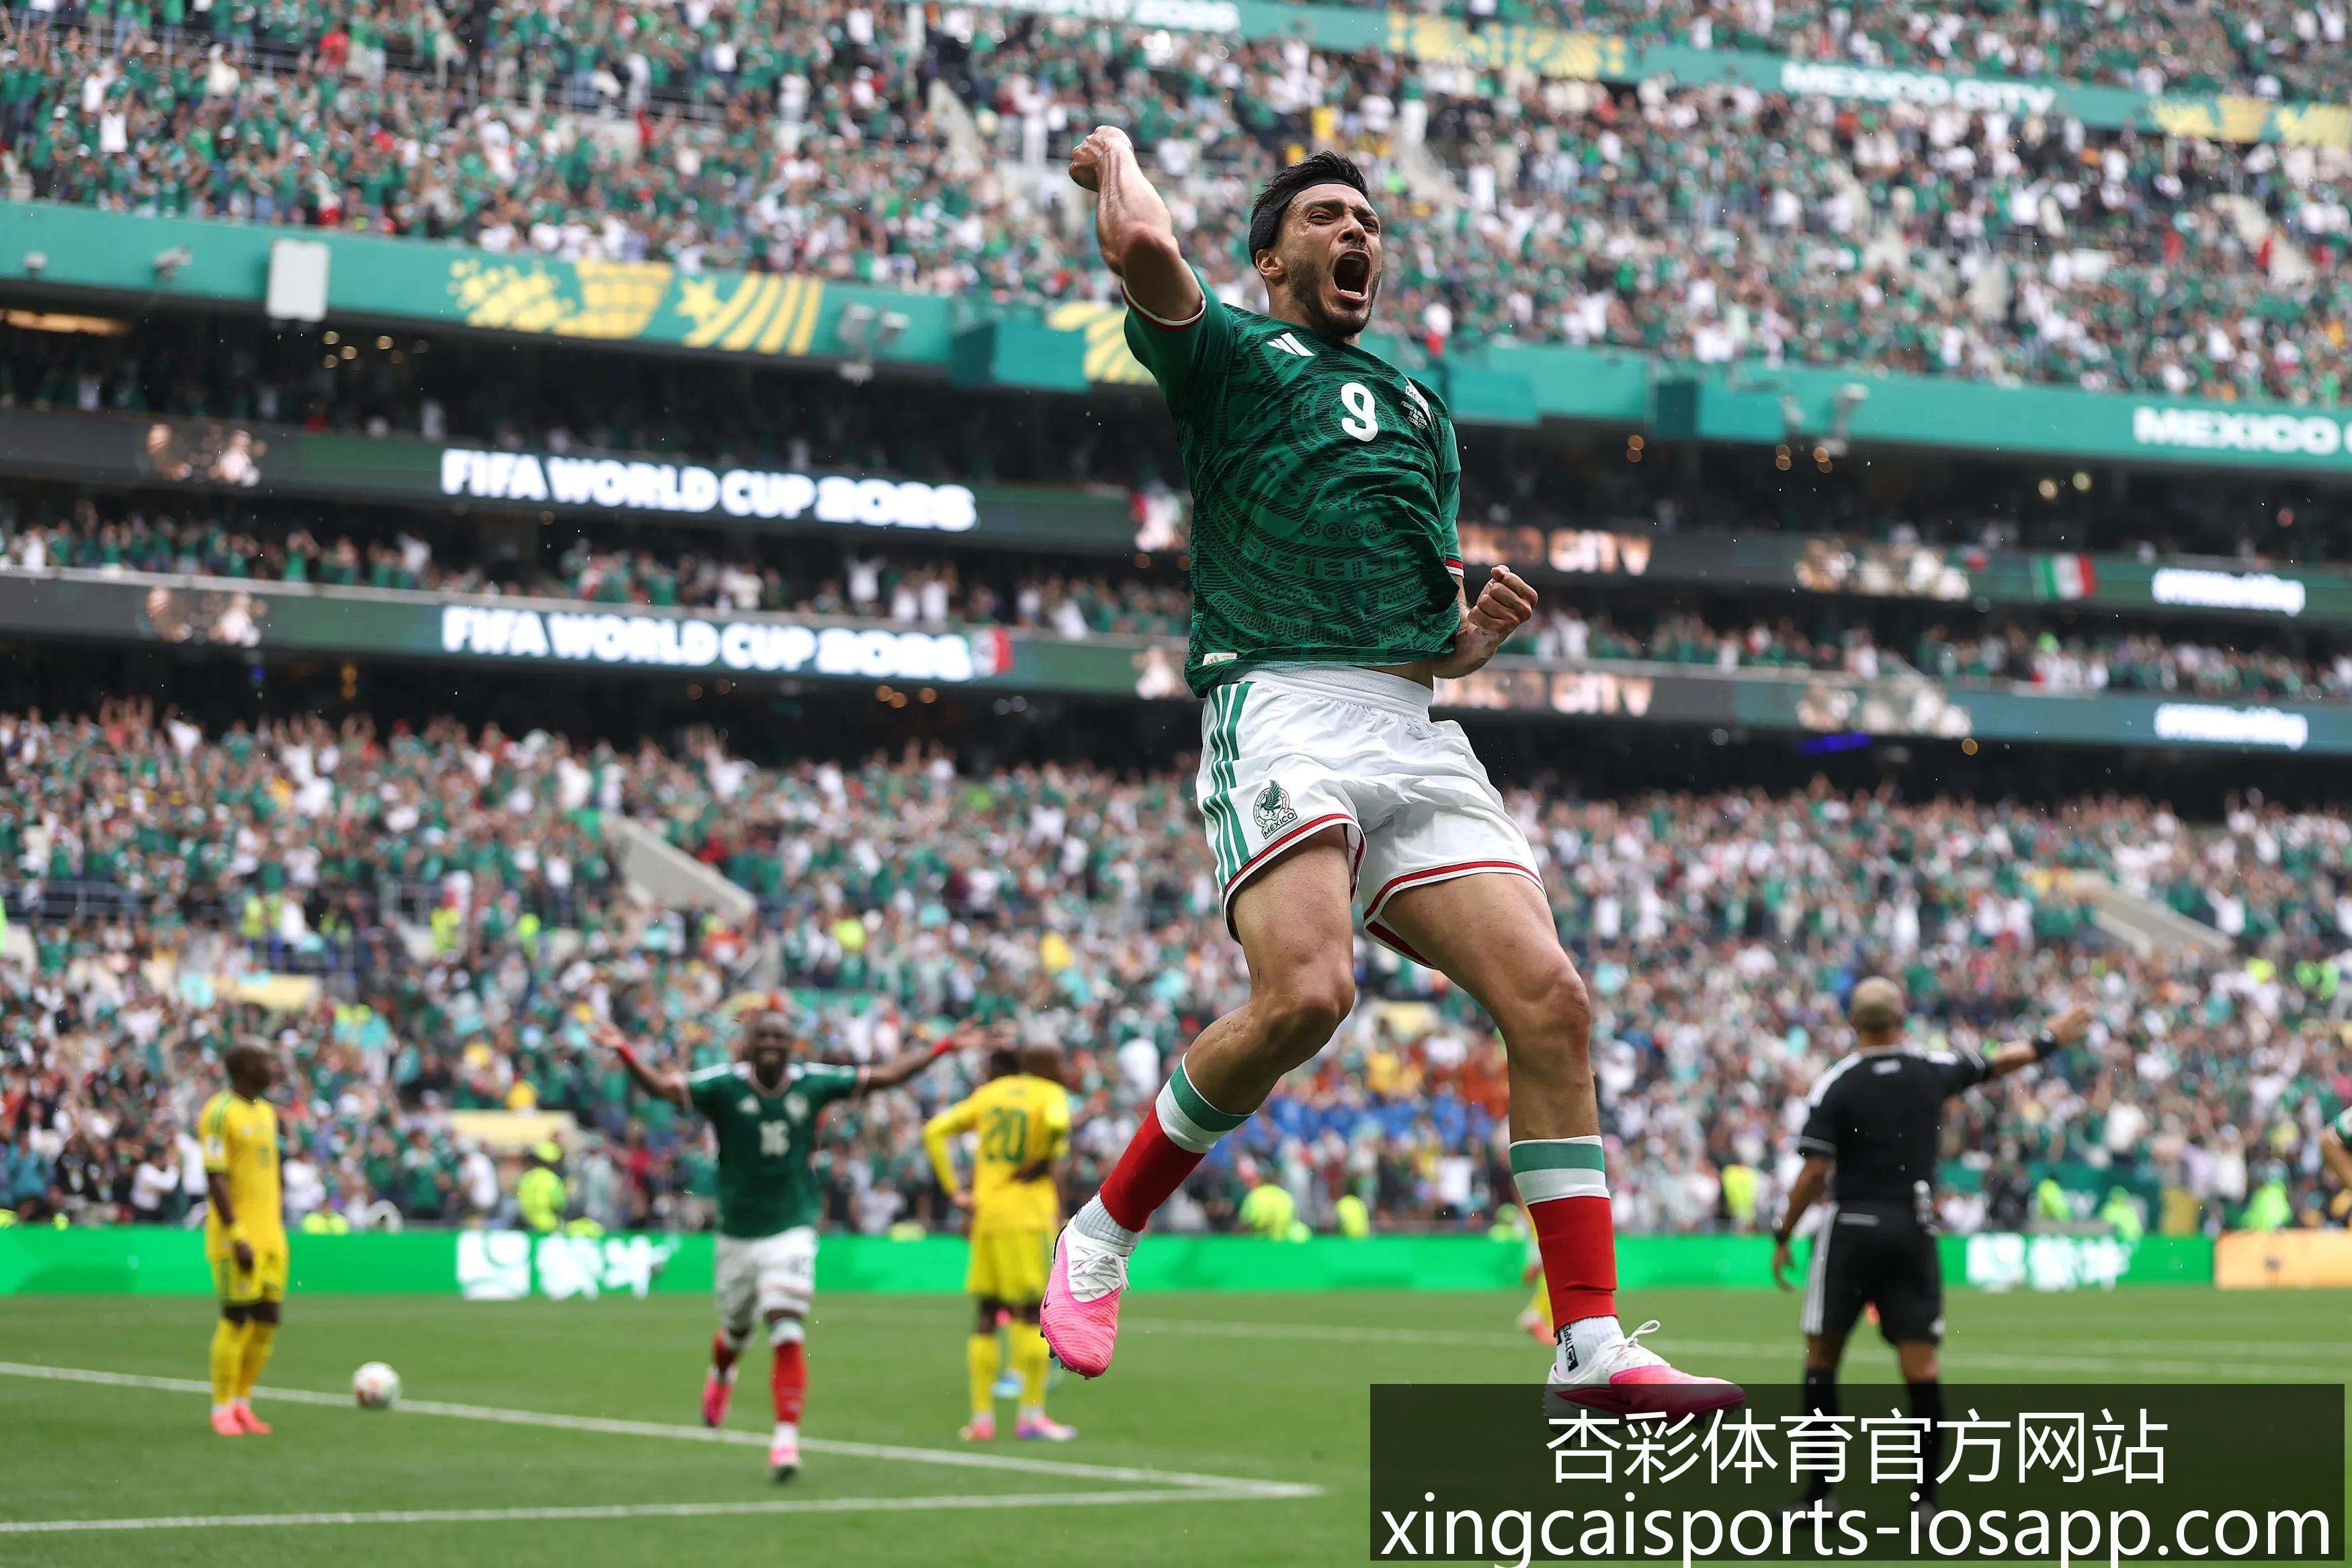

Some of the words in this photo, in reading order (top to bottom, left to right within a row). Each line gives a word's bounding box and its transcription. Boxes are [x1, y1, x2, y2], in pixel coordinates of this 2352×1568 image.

[1340, 382, 1379, 442] 9
[441, 448, 547, 501] FIFA
[546, 456, 720, 513] WORLD
[720, 470, 815, 519] CUP
[442, 606, 547, 656] FIFA
[546, 614, 720, 665] WORLD
[720, 623, 815, 670] CUP
[983, 1105, 1026, 1163] 20
